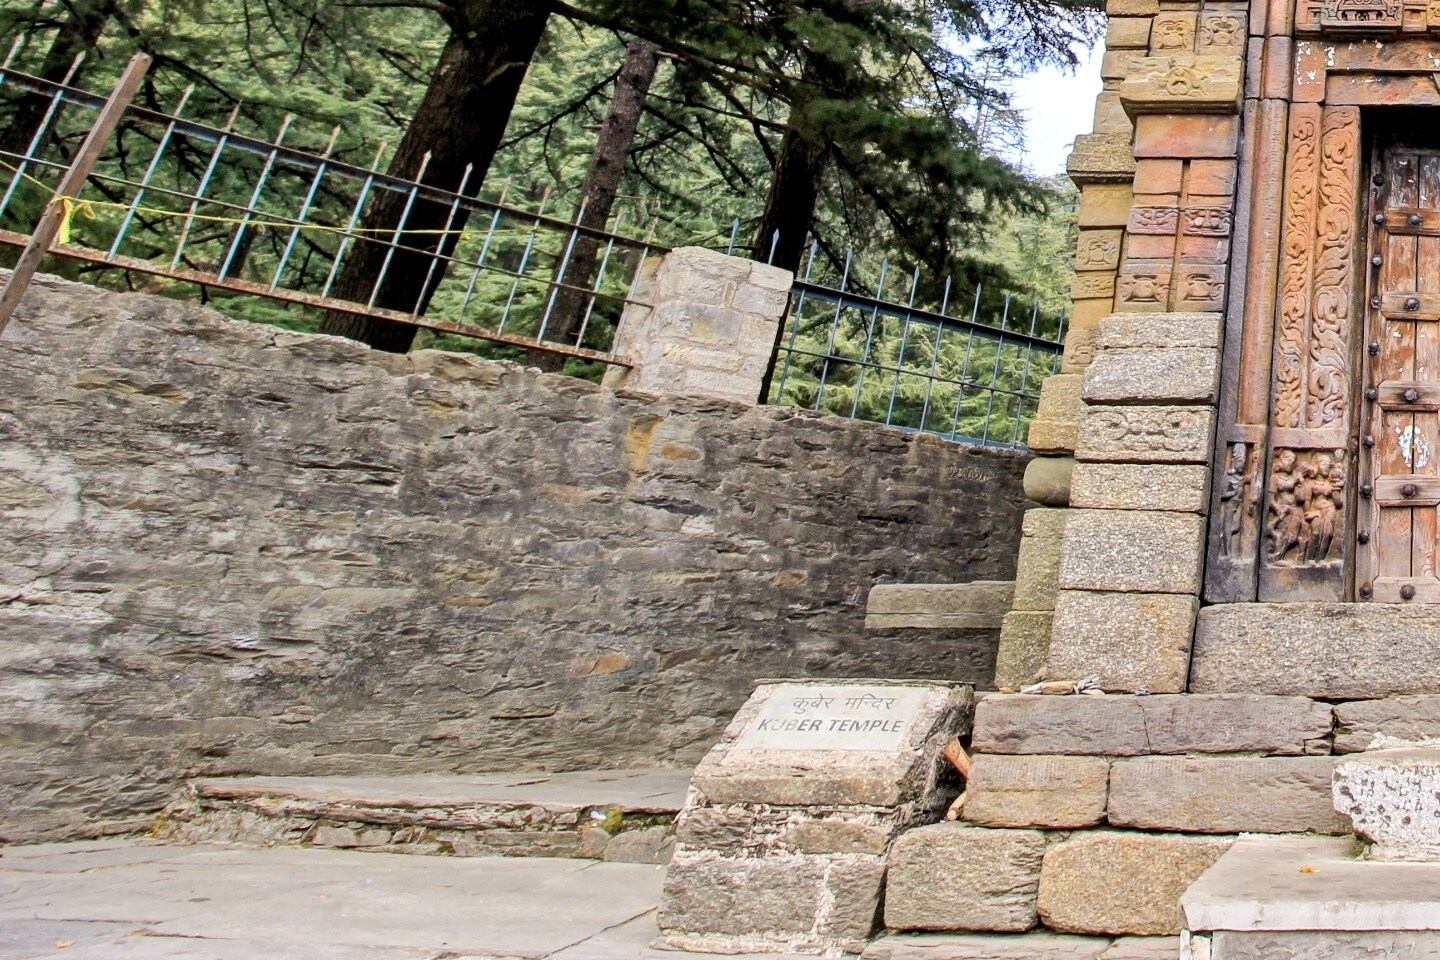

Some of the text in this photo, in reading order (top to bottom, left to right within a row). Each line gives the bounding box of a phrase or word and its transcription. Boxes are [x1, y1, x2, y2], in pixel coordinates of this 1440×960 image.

[793, 692, 896, 715] कुबेर मन्दिर
[757, 718, 903, 733] KUBER TEMPLE
